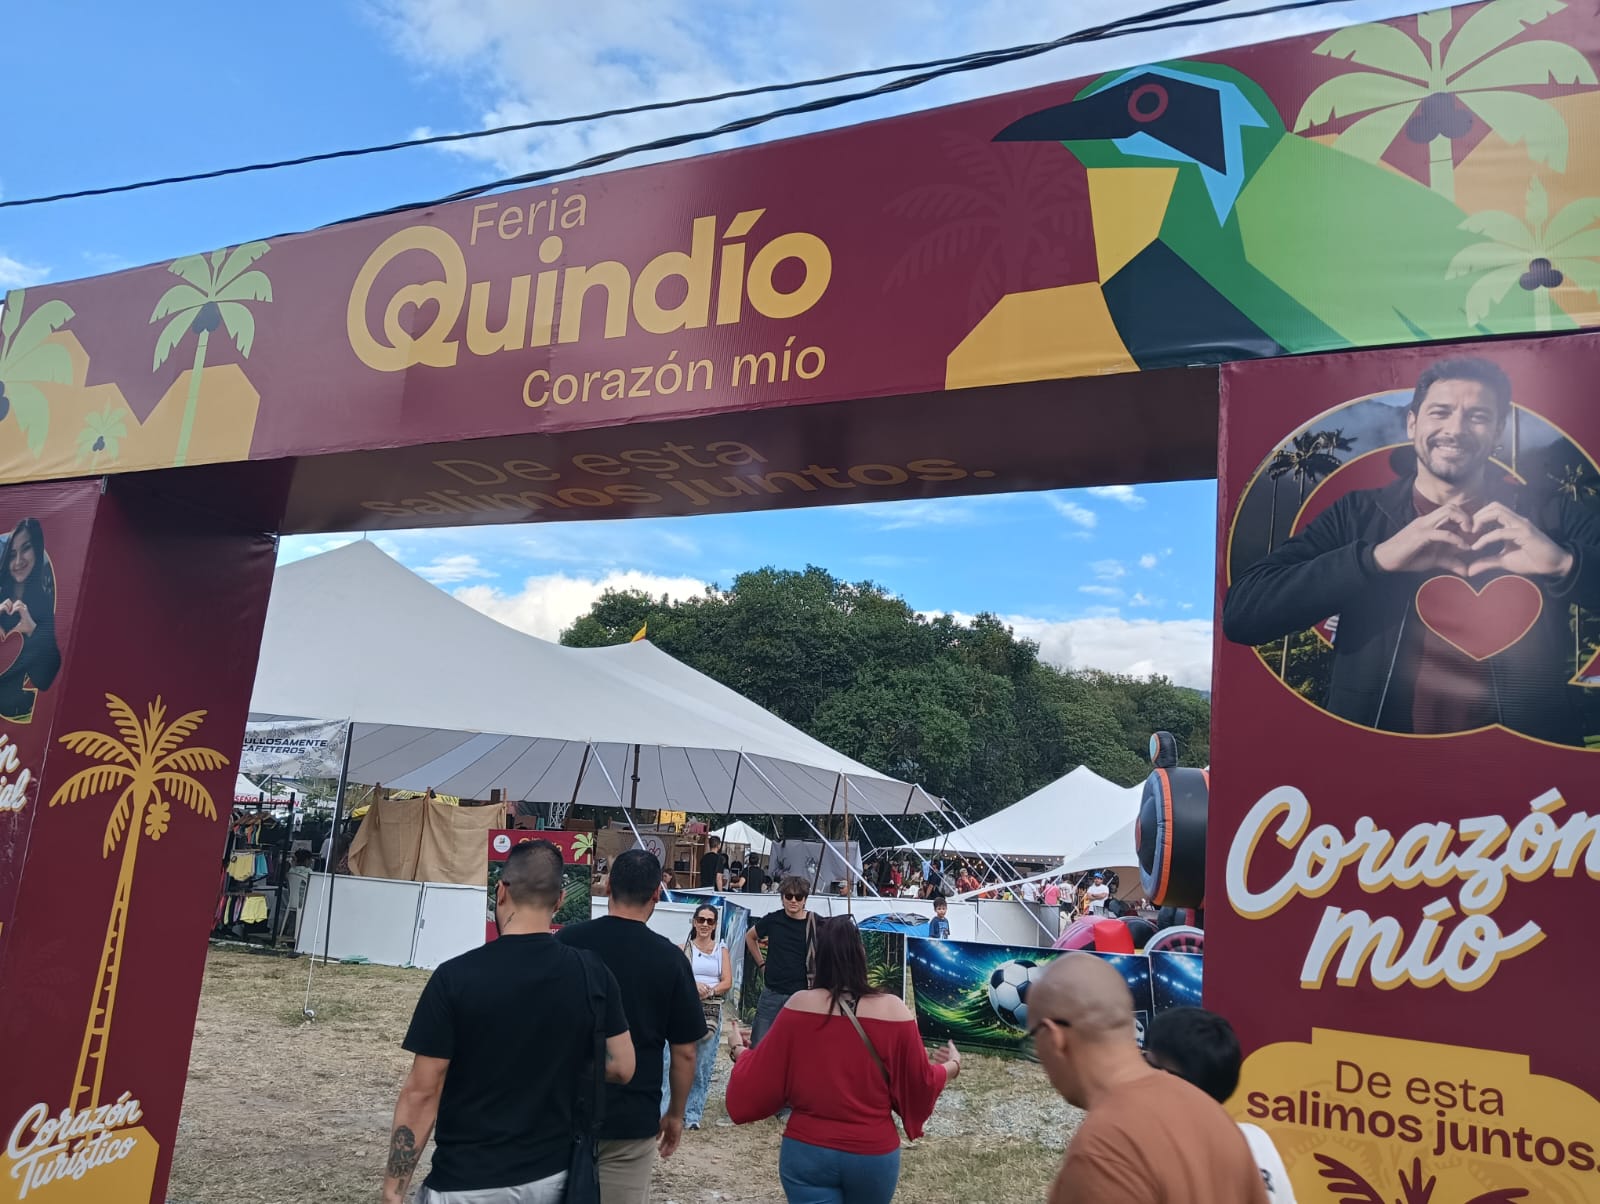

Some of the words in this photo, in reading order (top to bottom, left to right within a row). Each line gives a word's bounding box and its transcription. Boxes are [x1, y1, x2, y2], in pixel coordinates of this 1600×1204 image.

[470, 187, 588, 247] Feria
[346, 208, 832, 372] Quindío
[521, 350, 714, 409] Corazón
[731, 335, 827, 388] mío
[360, 484, 664, 517] salimos
[654, 458, 996, 506] juntos.
[432, 459, 560, 486] De
[571, 440, 769, 477] esta
[1226, 785, 1600, 920] Corazón
[1300, 897, 1547, 992] mío
[1246, 1089, 1423, 1143] salimos
[1336, 1060, 1392, 1099] De
[1405, 1078, 1504, 1117] esta
[7, 1090, 143, 1159] Corazón
[10, 1130, 137, 1200] Turístico
